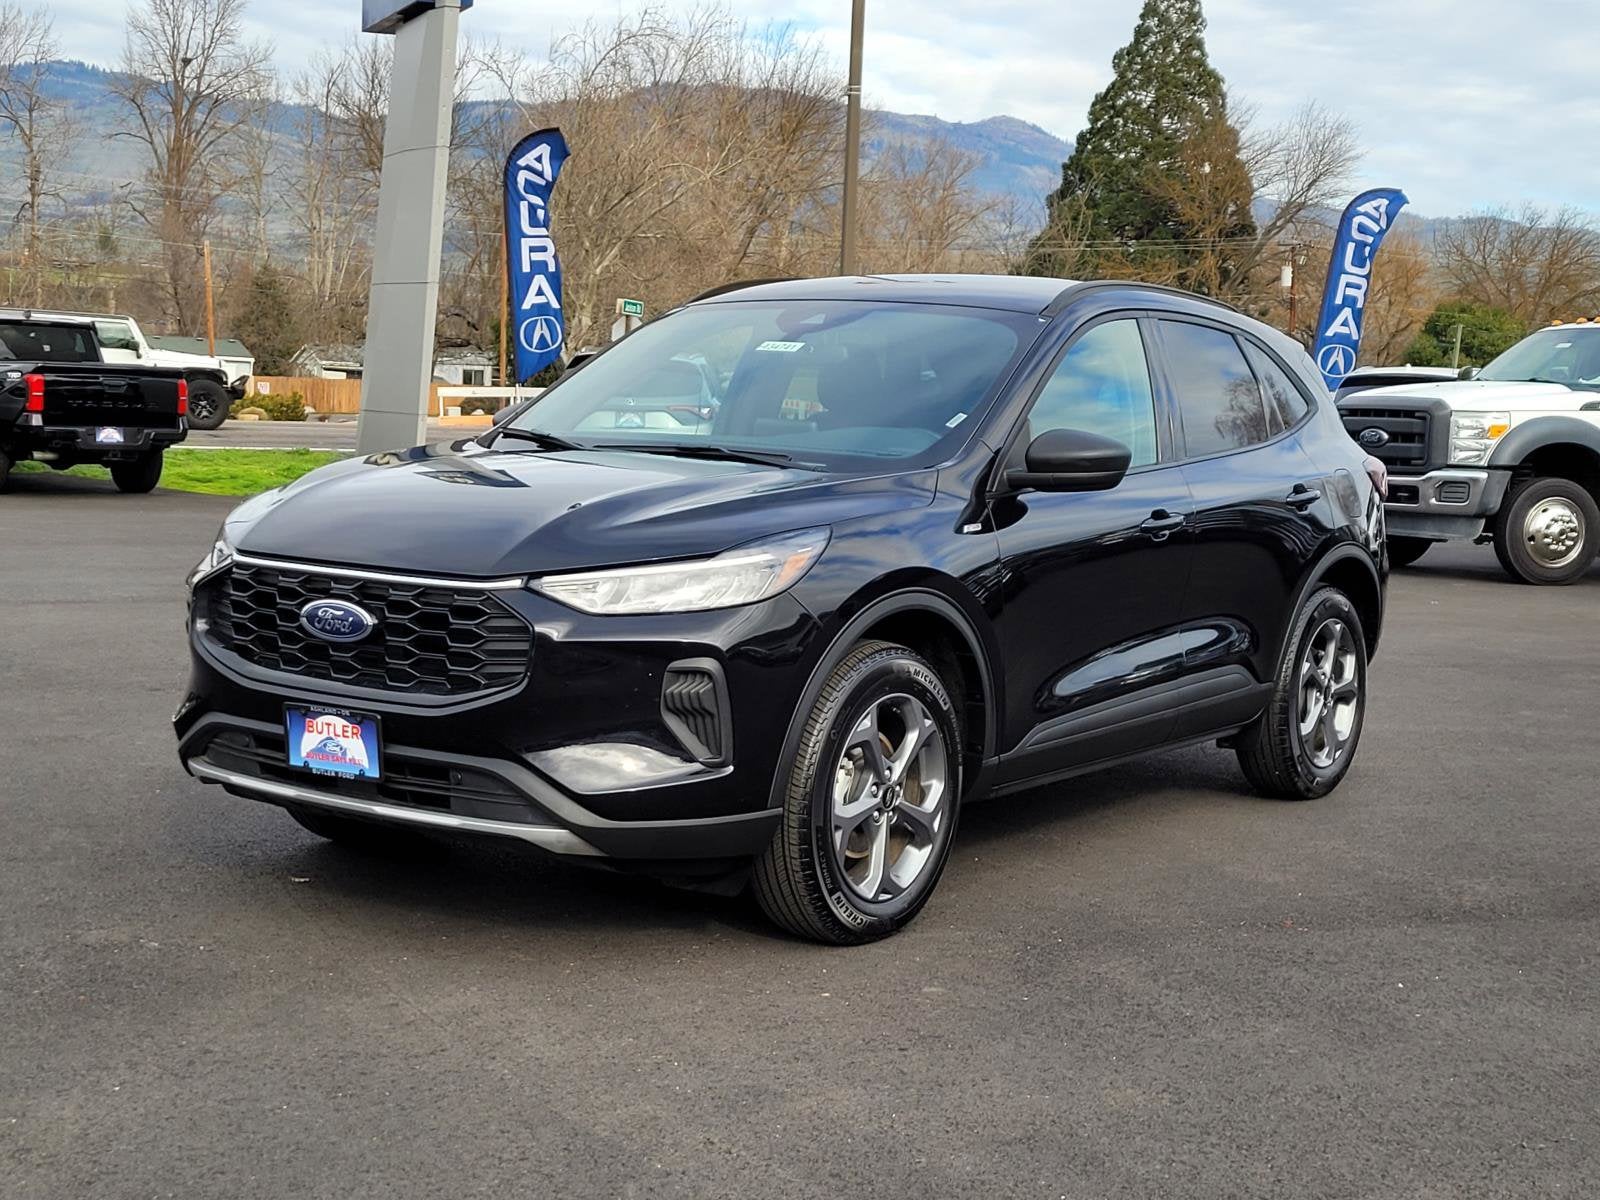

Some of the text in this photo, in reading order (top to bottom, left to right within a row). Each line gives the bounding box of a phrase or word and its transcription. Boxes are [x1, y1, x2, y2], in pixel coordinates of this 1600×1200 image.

[517, 143, 561, 310] ACURA
[1325, 198, 1390, 340] ACURA
[314, 607, 354, 632] Ford
[913, 668, 948, 706] MICHELIN
[306, 719, 361, 739] BUTLER
[834, 895, 869, 928] ICHELIN
